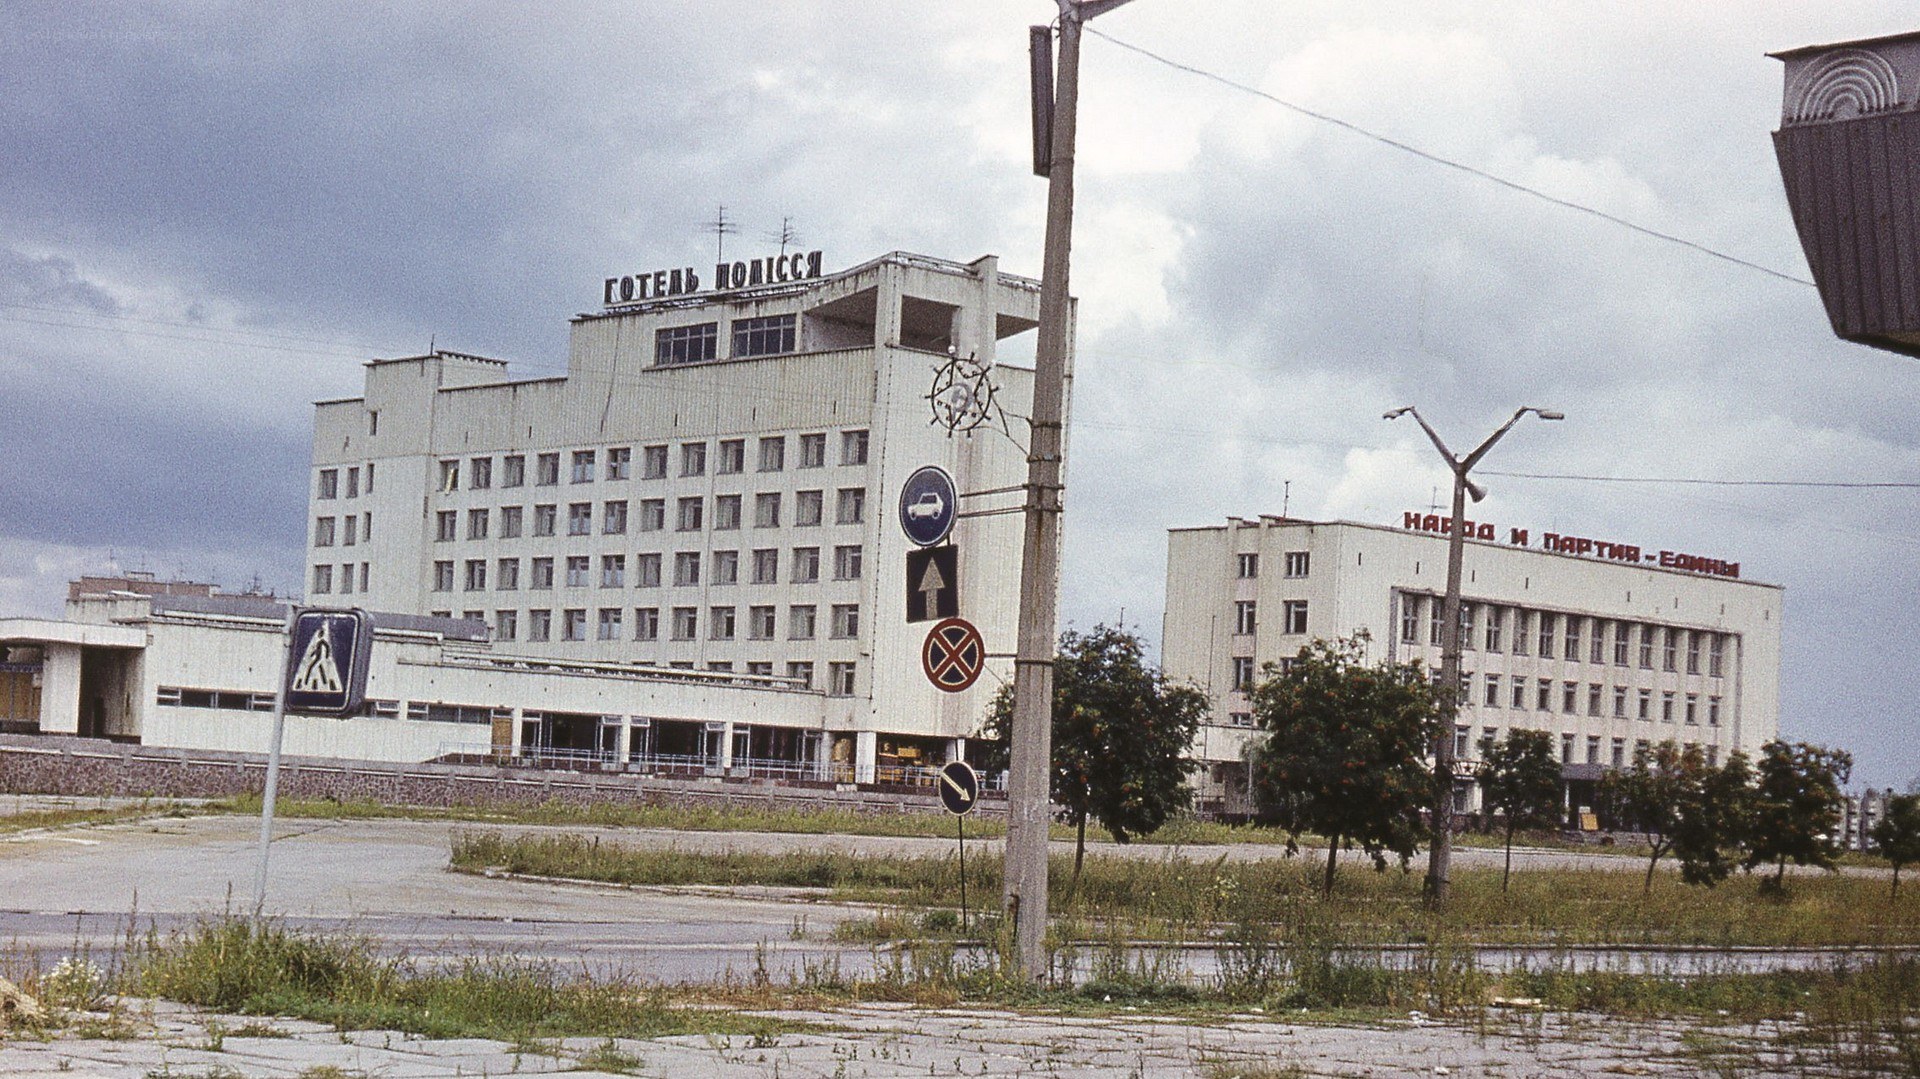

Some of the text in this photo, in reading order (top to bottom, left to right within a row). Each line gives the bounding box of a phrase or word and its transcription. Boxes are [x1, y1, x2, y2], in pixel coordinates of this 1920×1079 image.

[604, 250, 823, 304] ГОТЕЛЬ ПОЛІССЯ
[1404, 511, 1496, 541] НАРОД
[1510, 527, 1529, 546] И
